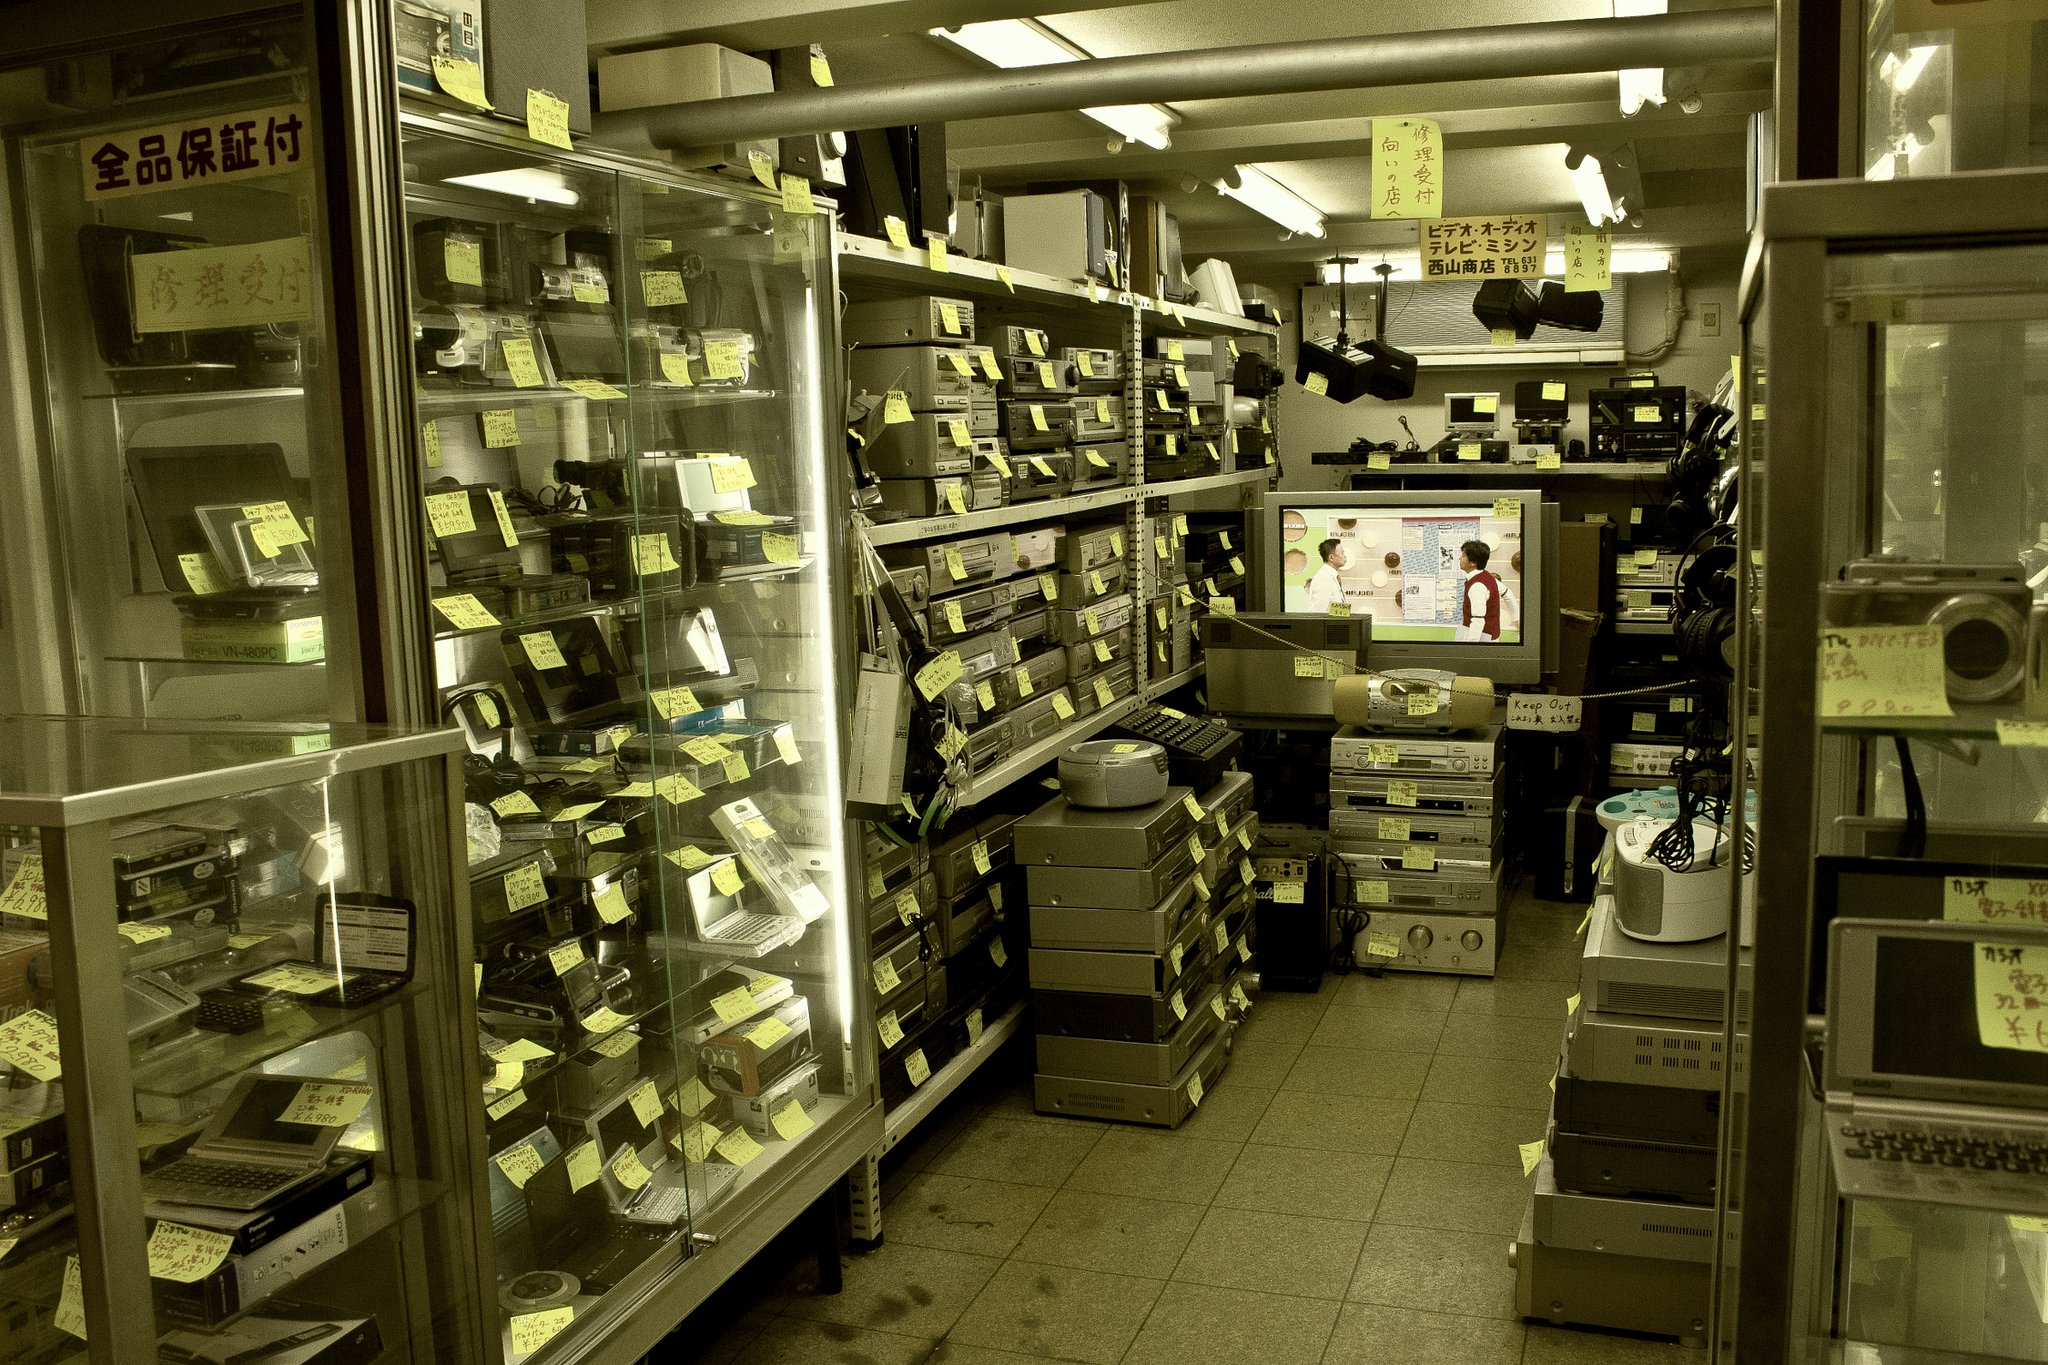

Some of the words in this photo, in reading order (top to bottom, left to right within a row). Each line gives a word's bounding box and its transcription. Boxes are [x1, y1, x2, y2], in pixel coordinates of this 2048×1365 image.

[91, 113, 303, 191] 全品保証付
[1412, 124, 1436, 205] 修理受付
[1381, 136, 1402, 217] 向いの店へ
[1428, 219, 1538, 238] ビデオ・オーディオ
[1428, 238, 1538, 256] テレビ・ミシン
[1571, 225, 1586, 279] 向いの店へ
[1428, 258, 1496, 276] 西山商店
[1501, 257, 1519, 265] TEL
[1521, 256, 1537, 264] 631
[1504, 264, 1537, 274] 8897
[149, 253, 308, 315] 修理受付
[1322, 293, 1329, 302] 11
[1360, 301, 1368, 311] 2
[1312, 303, 1321, 313] 10
[1308, 315, 1315, 325] 9
[1360, 328, 1367, 338] 4
[289, 619, 321, 629] OLYMPUS
[222, 645, 278, 660] VN-480PC
[1514, 699, 1543, 715] Keep
[1549, 698, 1572, 712] Out
[593, 827, 620, 841] ¥5980
[230, 879, 239, 914] OLYMPUS
[1952, 879, 1989, 897] カシオ
[1981, 945, 2025, 966] カシオ
[334, 1212, 345, 1245] SONY
